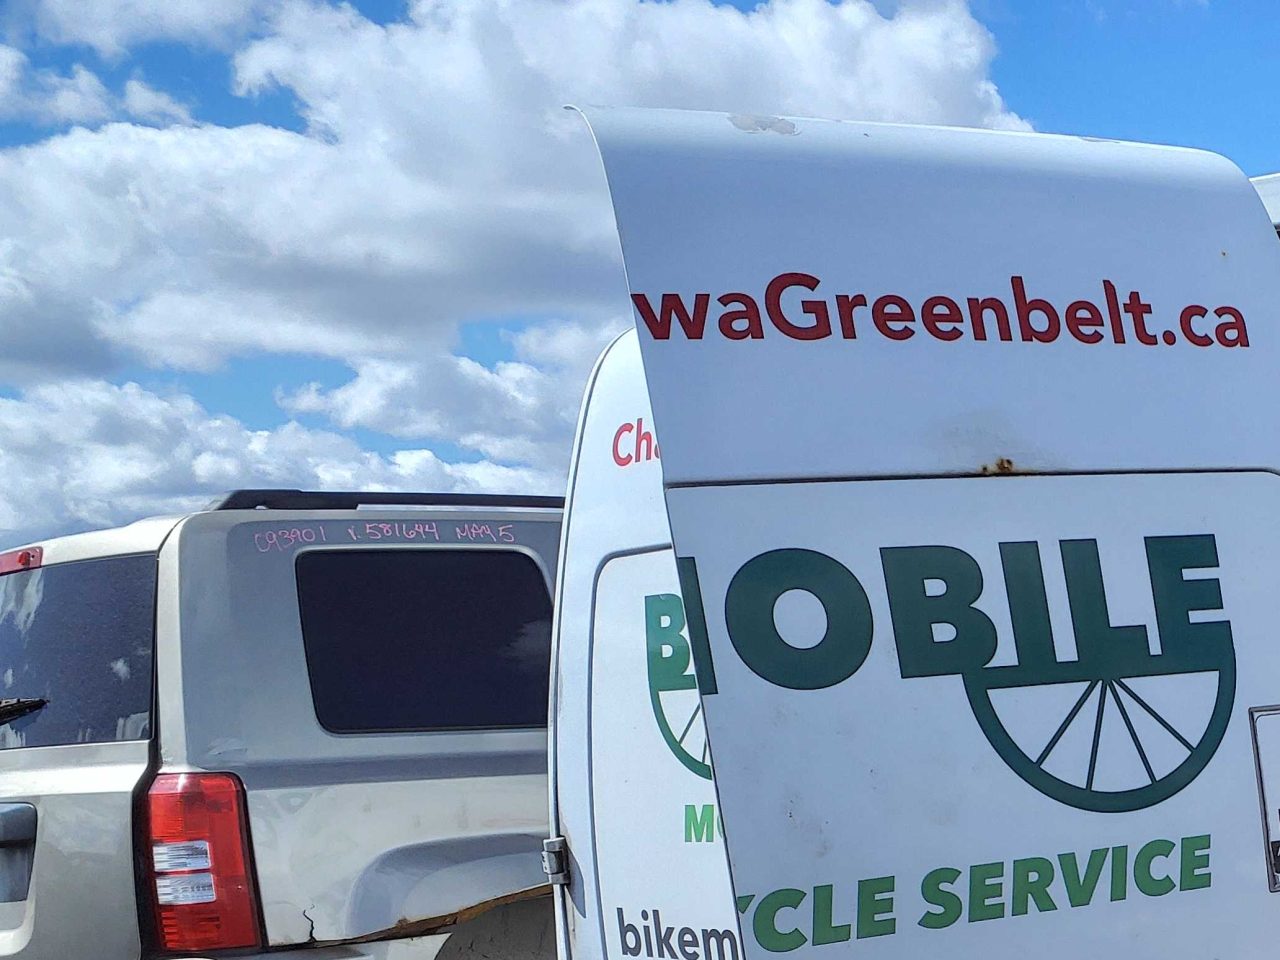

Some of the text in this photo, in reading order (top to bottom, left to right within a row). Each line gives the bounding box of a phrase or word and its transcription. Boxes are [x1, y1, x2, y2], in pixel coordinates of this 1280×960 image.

[630, 272, 1250, 348] waGreenbelt.ca
[612, 417, 660, 467] Ch
[684, 804, 725, 842] M
[917, 834, 1212, 930] SERVICE
